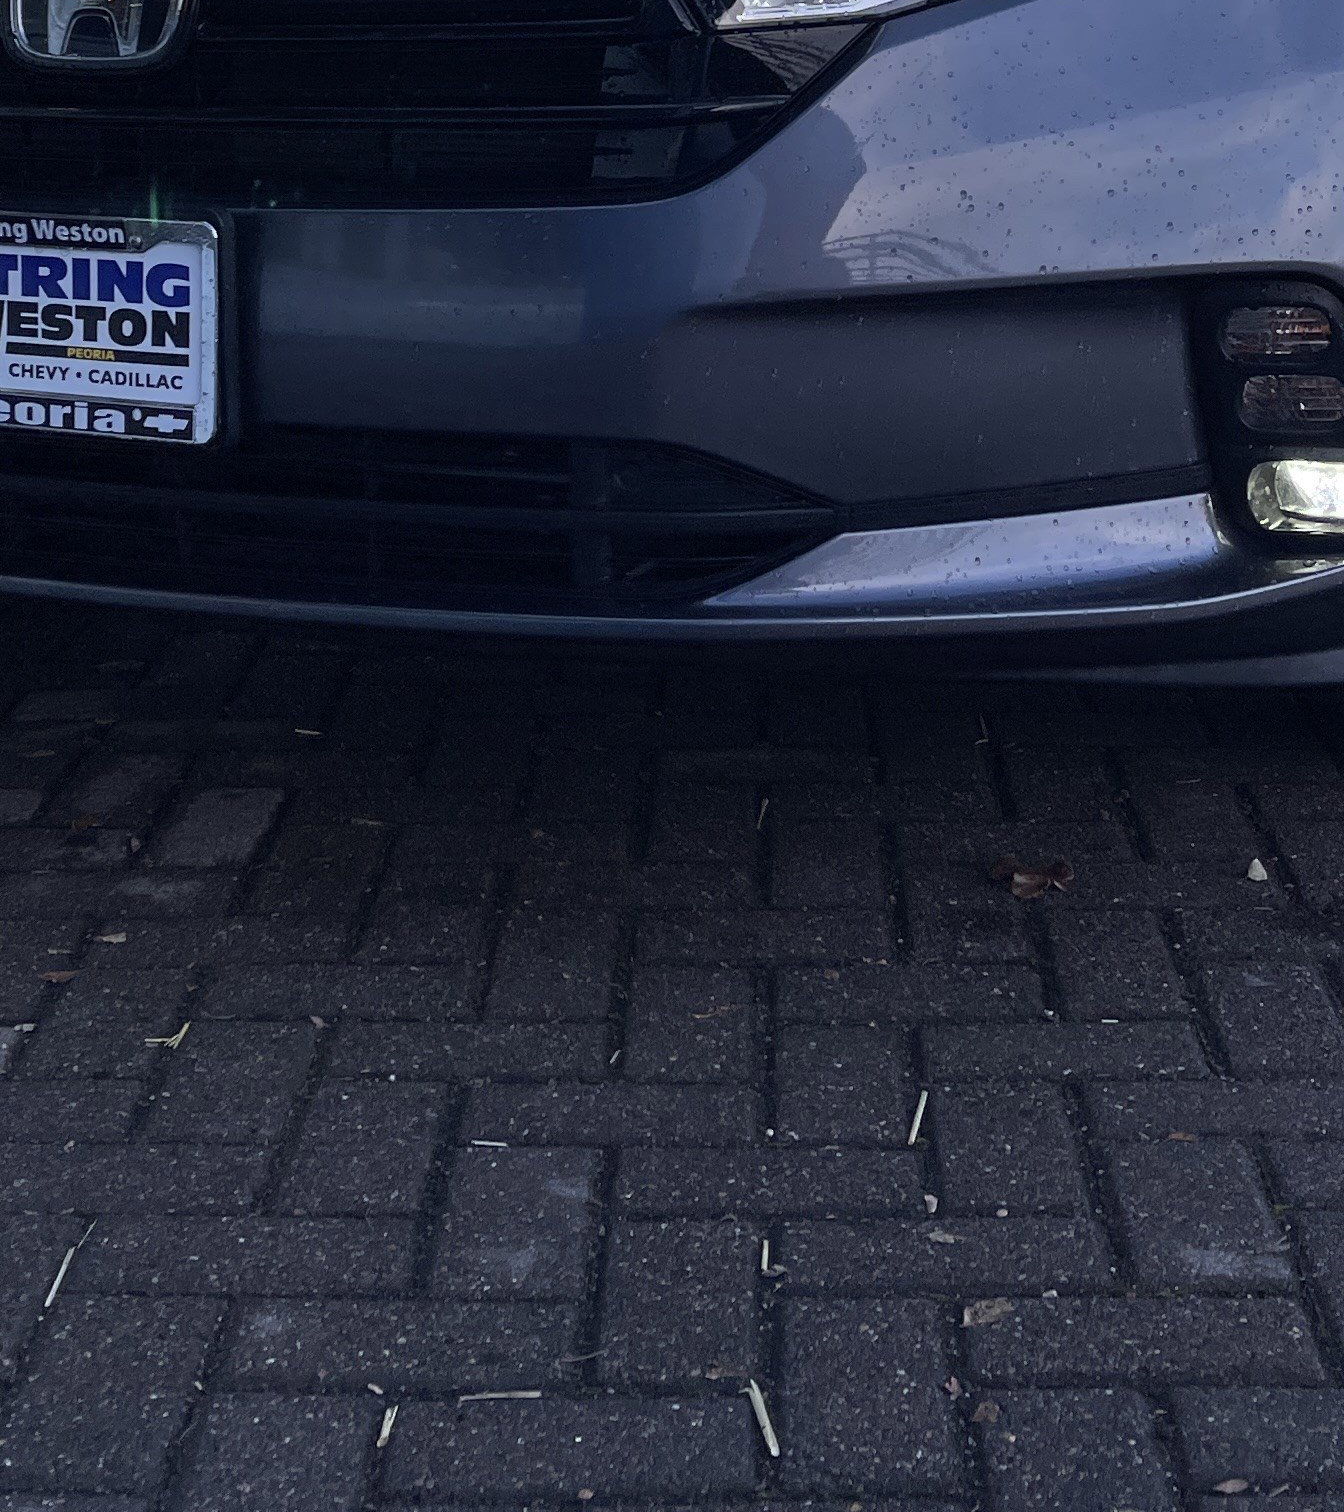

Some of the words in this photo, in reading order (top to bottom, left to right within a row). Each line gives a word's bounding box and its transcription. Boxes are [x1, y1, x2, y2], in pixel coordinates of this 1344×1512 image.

[30, 219, 125, 243] Weston
[67, 347, 116, 361] PEORIA
[8, 363, 70, 381] CHEVY
[88, 369, 183, 390] CADILLAC
